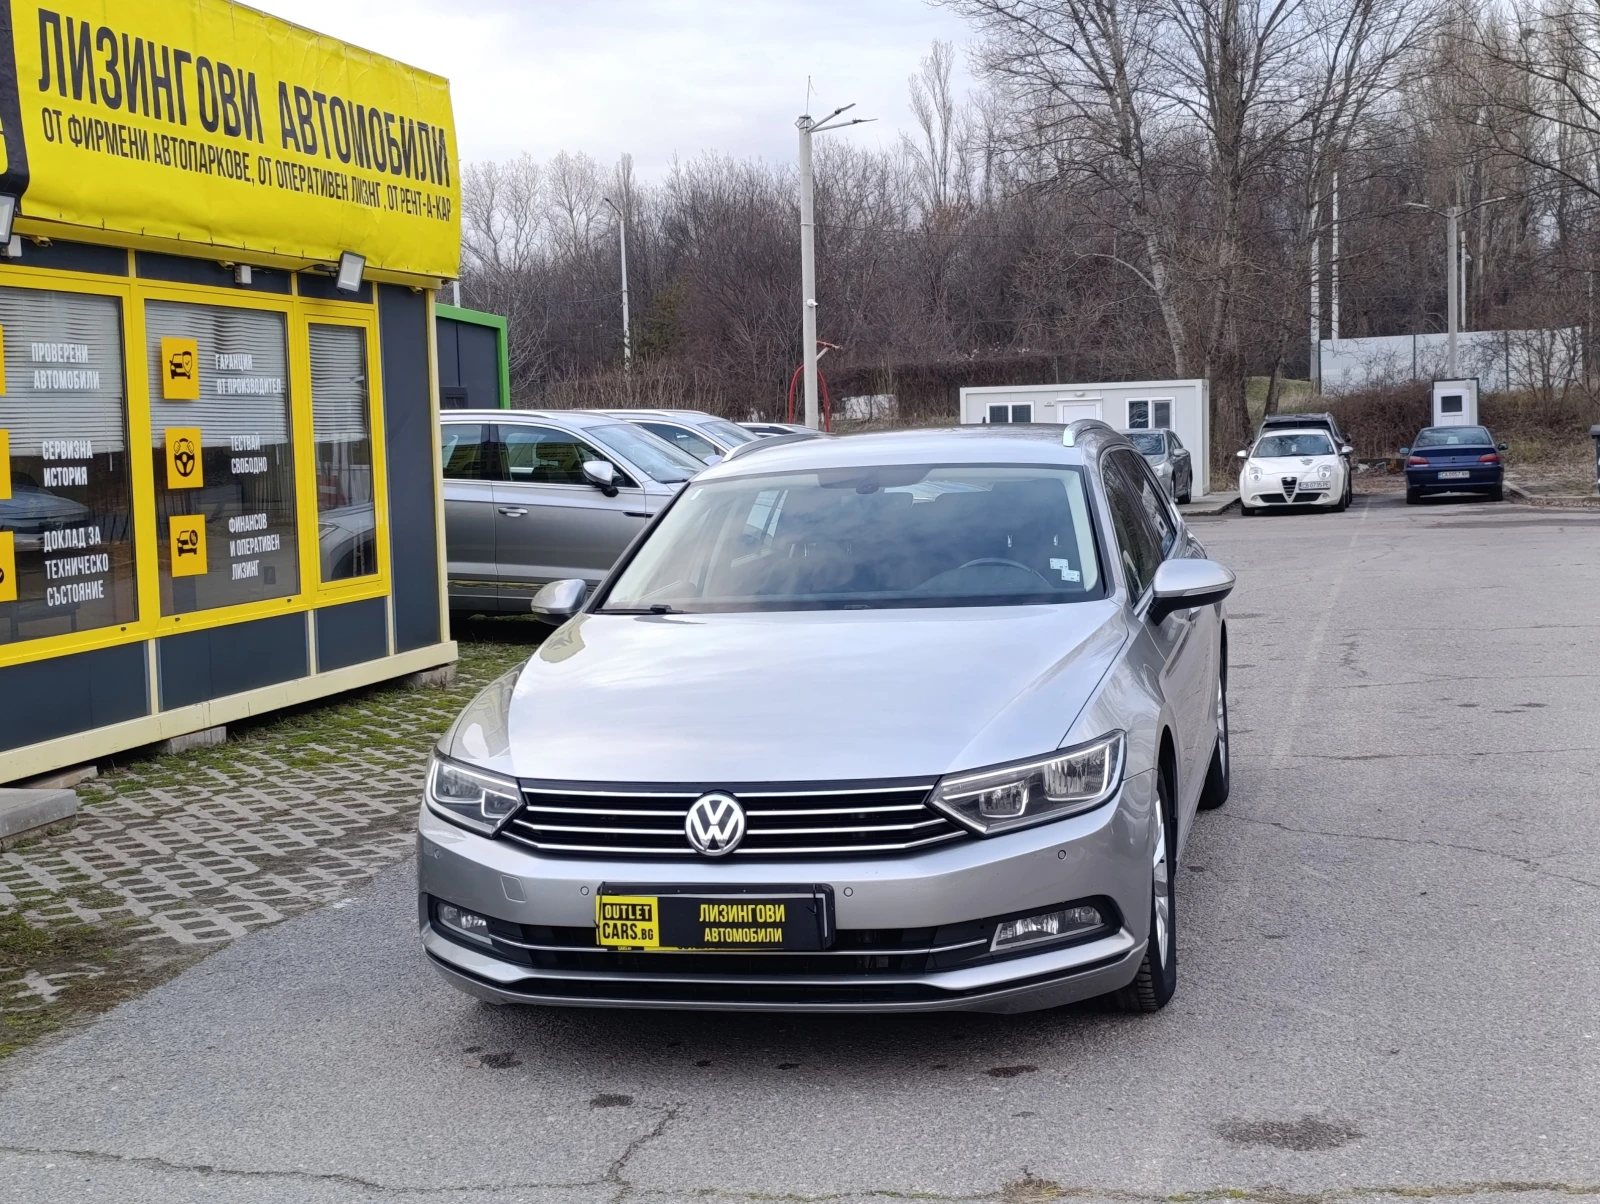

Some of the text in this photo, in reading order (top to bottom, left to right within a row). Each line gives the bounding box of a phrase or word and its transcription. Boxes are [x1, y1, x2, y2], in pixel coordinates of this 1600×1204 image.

[38, 7, 451, 188] ЛИЗИНГОВИ АВТОМОБИЛИ
[41, 107, 63, 144] ОТ
[67, 114, 150, 162] ФИРМЕНИ
[153, 132, 255, 187] АВТОПАРКОВЕ,
[257, 155, 273, 187] ОТ
[275, 159, 349, 202] ОПЕРАТИВЕН
[387, 184, 400, 212] ОТ
[400, 187, 452, 222] РЕНТ-А-КАР
[31, 343, 89, 362] ПРОВЕРЕНИ
[215, 353, 253, 371] ГАРАНЦИЯ
[34, 370, 100, 389] АВТОМОБИЛИ
[217, 378, 281, 395] ОТ ПРОИЗВОДИТЕЛ
[42, 440, 93, 460] СЕРВИЗНА
[231, 432, 261, 451] ТЕСТВАЙ
[231, 456, 267, 475] СВОБОДНО
[43, 466, 88, 487] ИСТОРИЯ
[228, 513, 268, 533] ФИНАНСОВ
[44, 526, 101, 553] ДОКЛАД ЗА
[230, 533, 280, 557] И ОПЕРАТИВЕН
[45, 553, 109, 579] ТЕХНИЧЕСКО
[232, 559, 259, 580] ЛИЗИНГ
[47, 580, 104, 606] СЪСТОЯНИЕ
[604, 904, 651, 920] OUTLET
[699, 904, 785, 923] ЛИЗИНГОВИ
[602, 922, 654, 941] CARS.BG
[704, 928, 783, 943] АВТОМОБИЛИ
